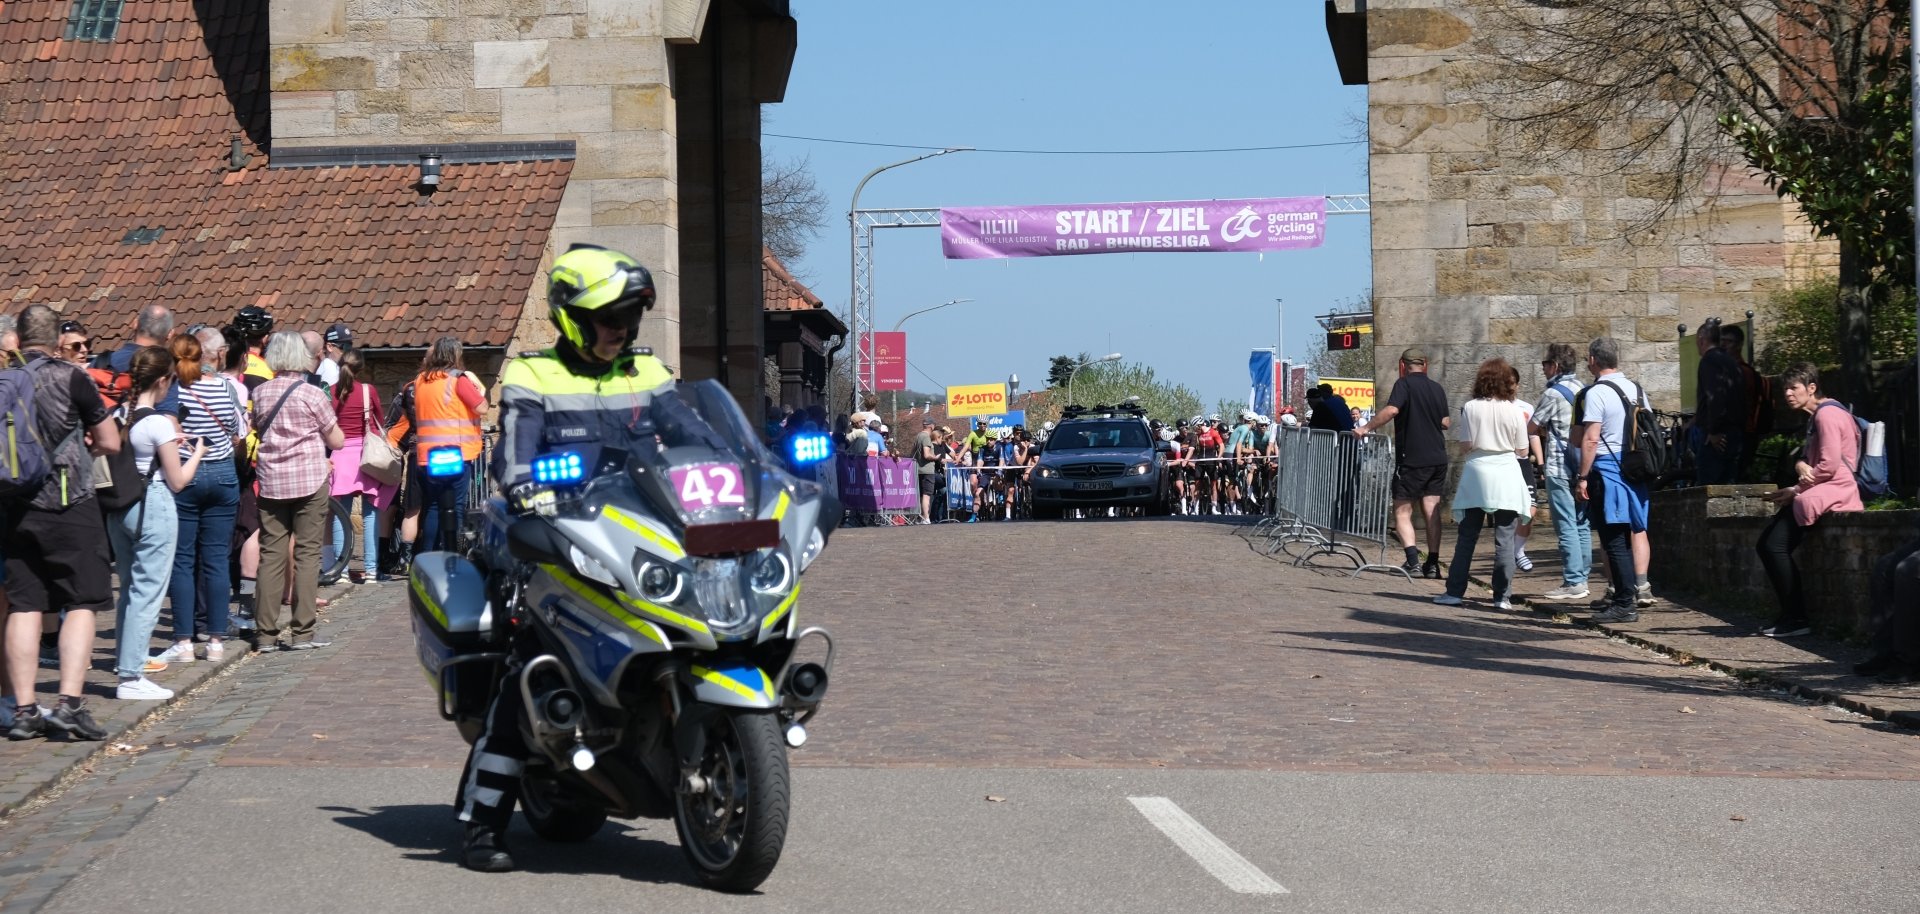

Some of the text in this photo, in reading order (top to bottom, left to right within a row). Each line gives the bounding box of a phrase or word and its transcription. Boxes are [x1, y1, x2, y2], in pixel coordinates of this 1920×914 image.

[1055, 207, 1210, 235] START / ZIEL
[1267, 212, 1318, 224] german
[1267, 222, 1315, 236] cycling
[951, 236, 979, 245] MÜLLER
[1055, 238, 1089, 251] RAD
[1106, 234, 1210, 249] BUNDESLIGA
[1343, 334, 1352, 347] 0
[966, 392, 1003, 404] LOTTO
[1338, 387, 1374, 398] LOTTO
[561, 428, 587, 438] POLIZEI
[681, 466, 745, 505] 42
